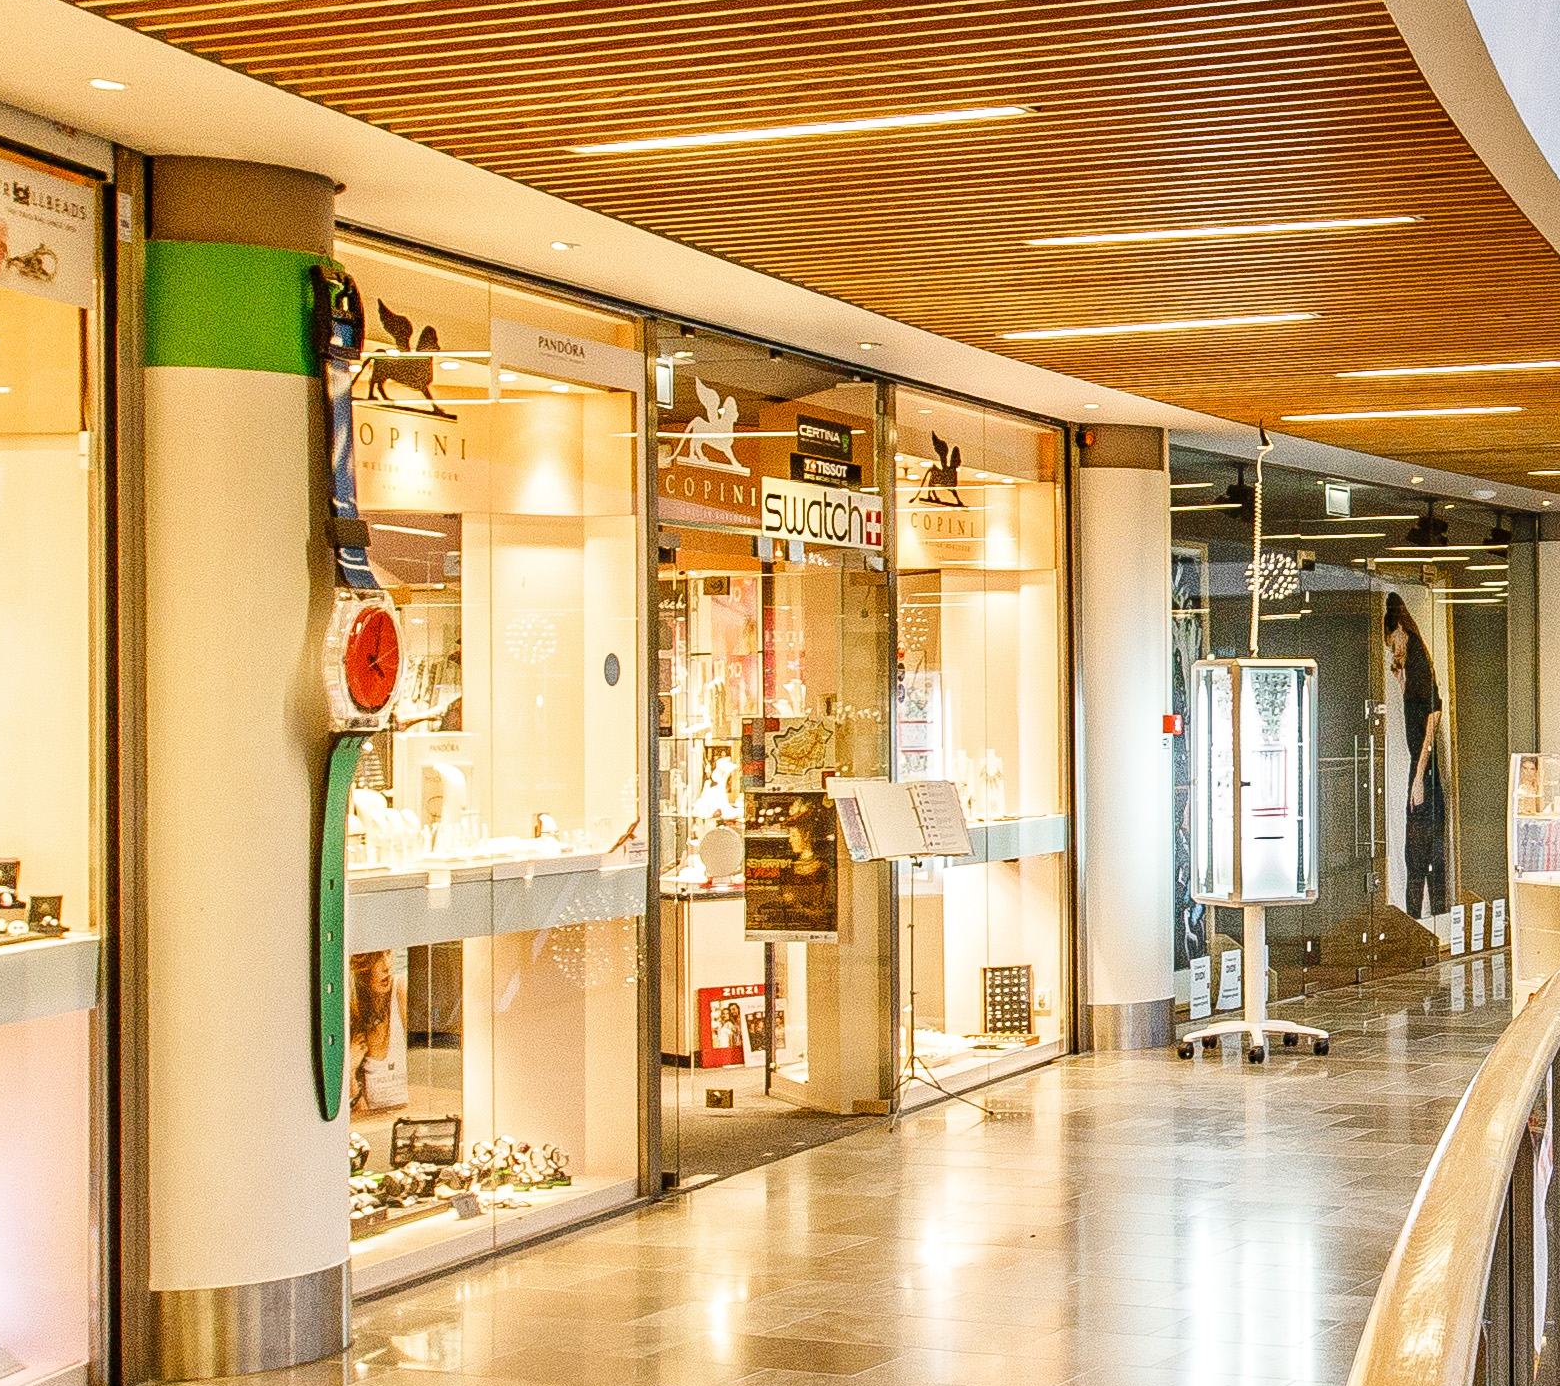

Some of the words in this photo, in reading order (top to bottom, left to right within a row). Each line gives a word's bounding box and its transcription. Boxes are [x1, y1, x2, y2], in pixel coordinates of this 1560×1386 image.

[359, 422, 466, 460] OPINI
[798, 424, 841, 443] CERTINA
[665, 474, 756, 507] COPINI
[765, 491, 864, 545] swatch
[910, 512, 974, 538] COPINI
